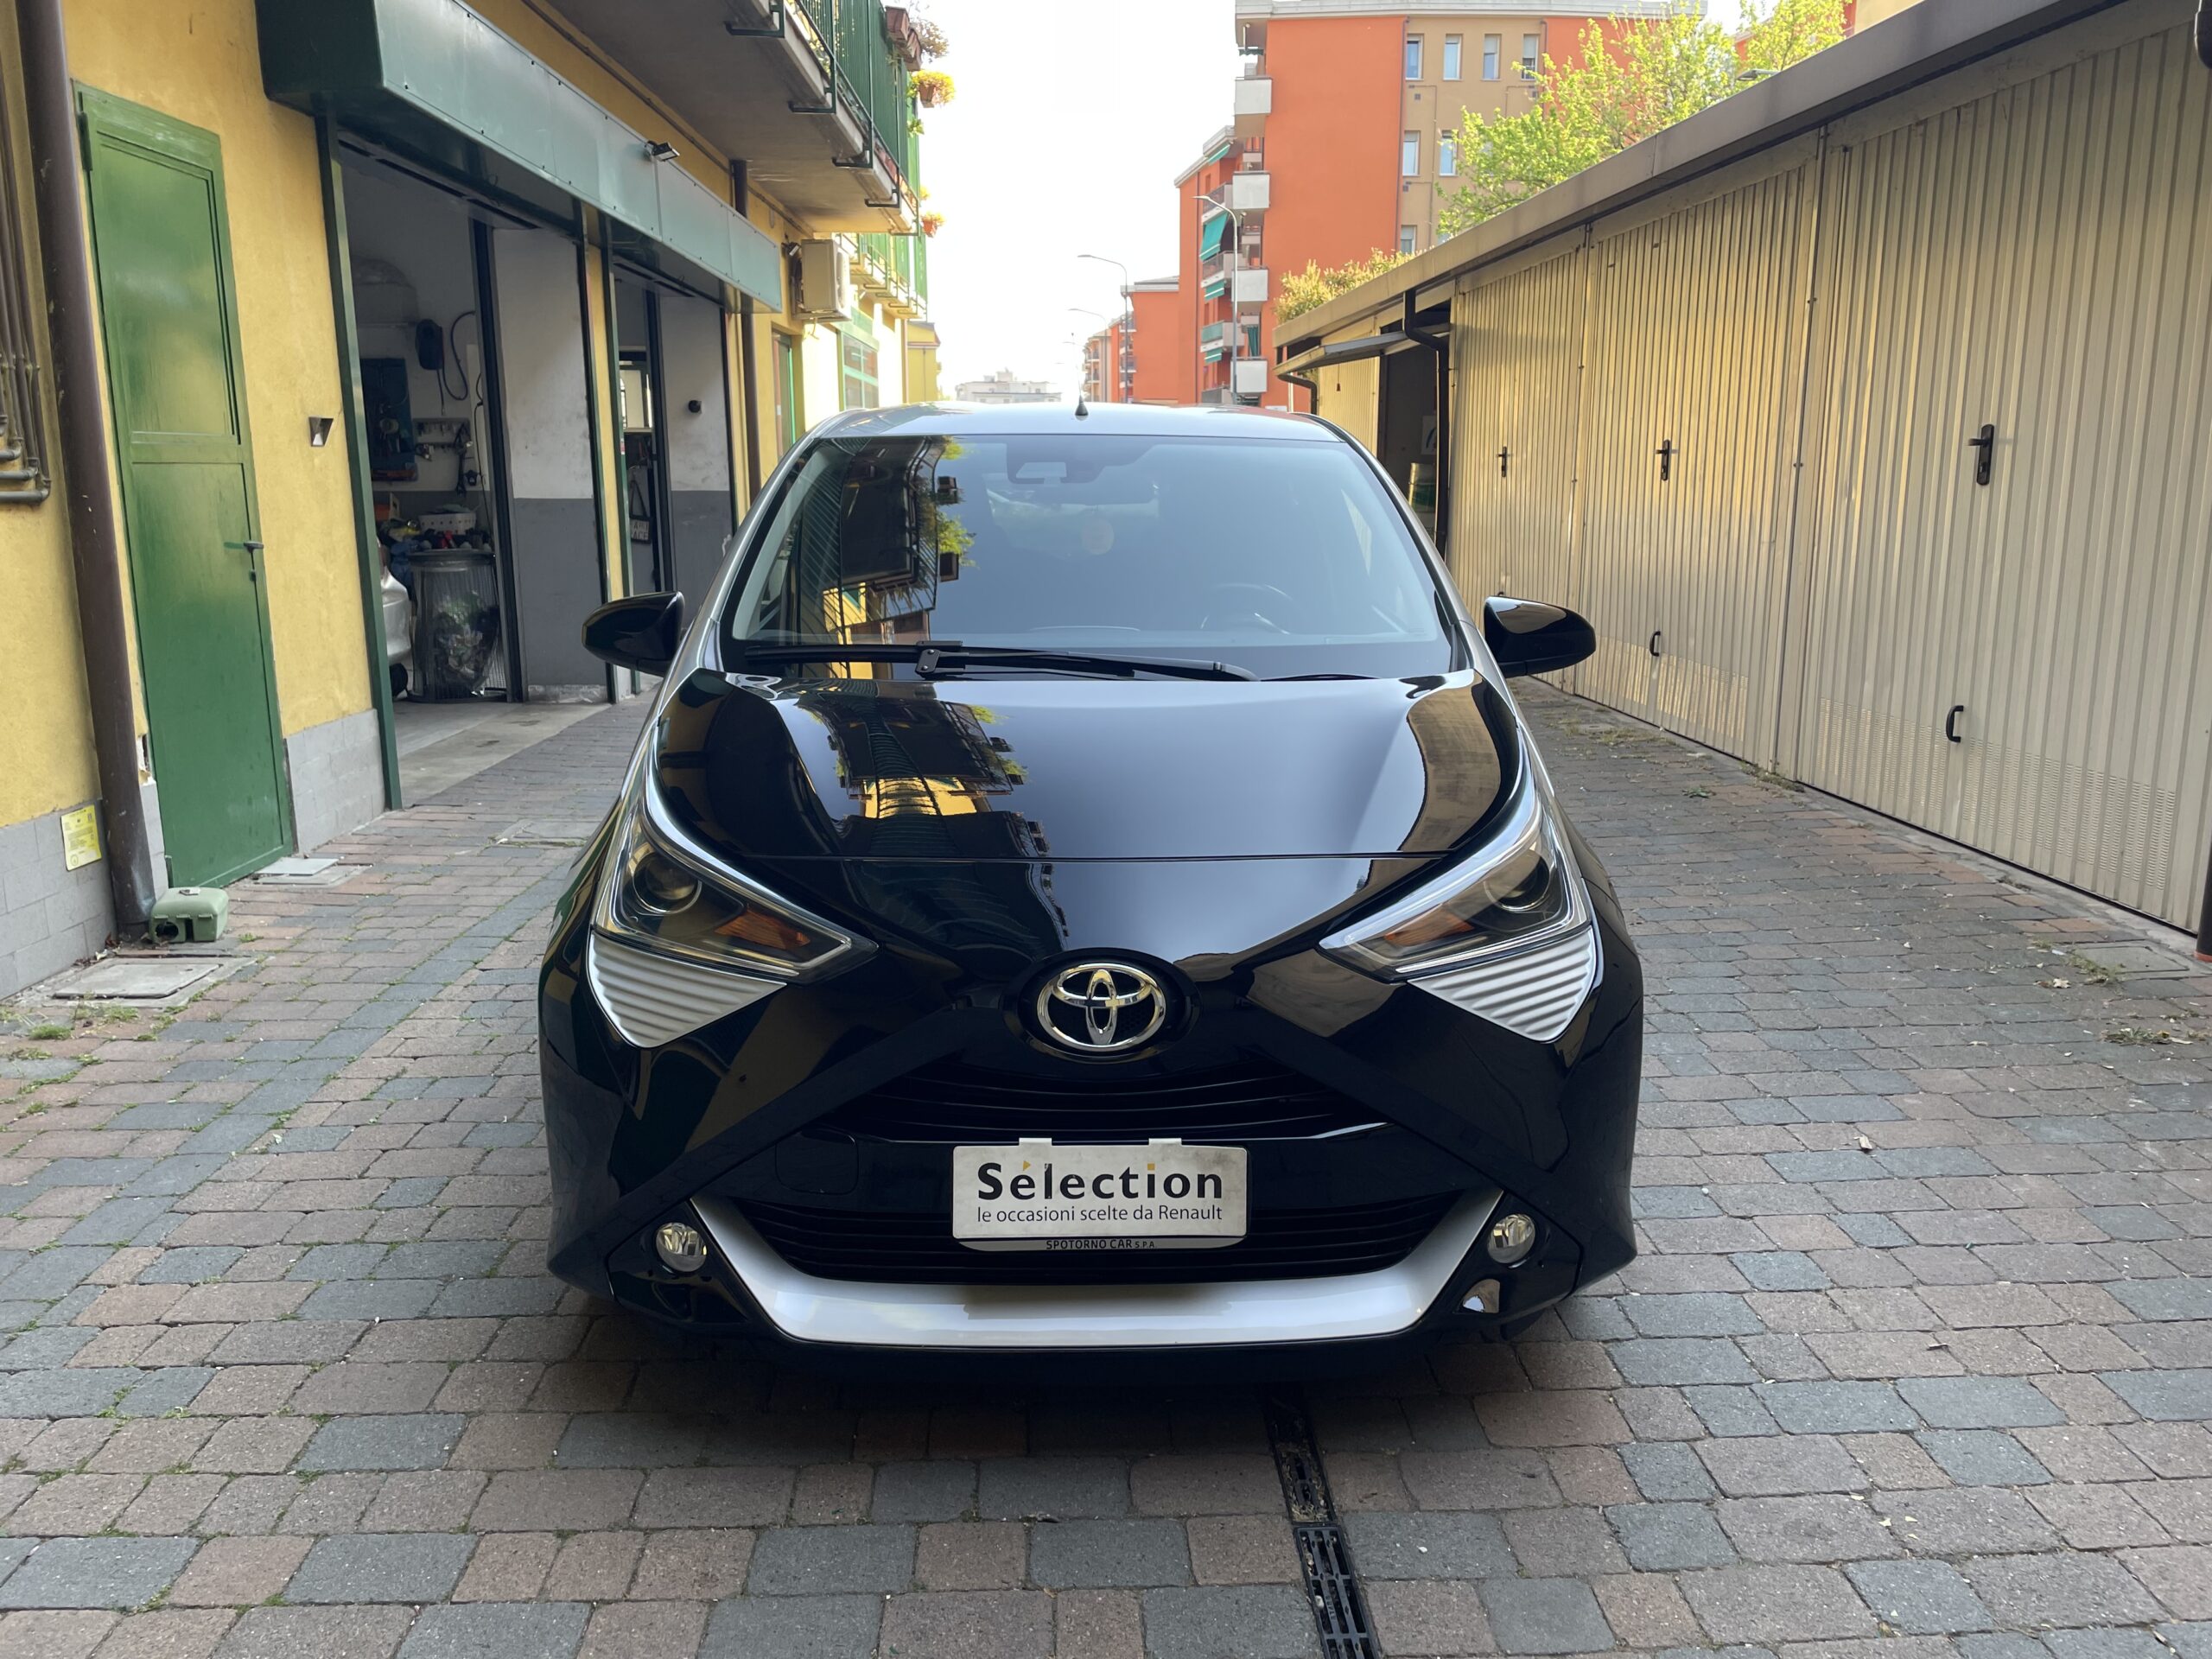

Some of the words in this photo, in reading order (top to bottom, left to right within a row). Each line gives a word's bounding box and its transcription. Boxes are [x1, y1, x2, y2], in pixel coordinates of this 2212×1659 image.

[977, 1206, 992, 1223] le
[996, 1205, 1075, 1223] occasioni
[1080, 1205, 1128, 1221] scelte
[1133, 1204, 1154, 1221] da
[1159, 1204, 1223, 1220] Renault
[1046, 1239, 1107, 1250] SPOTORNO
[1109, 1239, 1133, 1249] CAR
